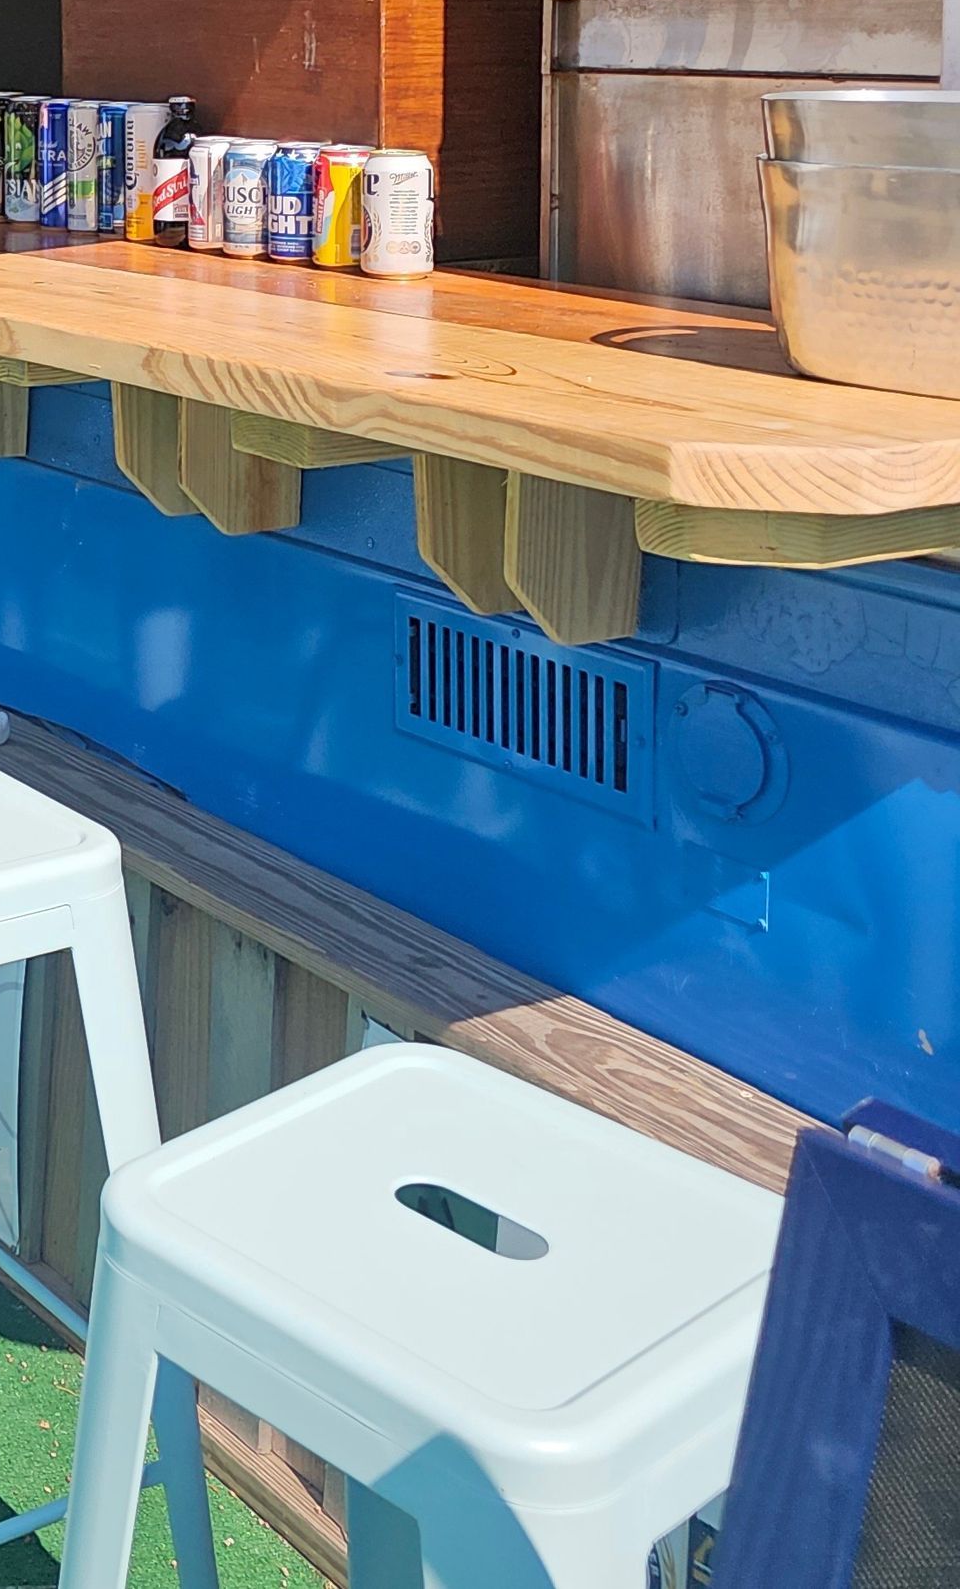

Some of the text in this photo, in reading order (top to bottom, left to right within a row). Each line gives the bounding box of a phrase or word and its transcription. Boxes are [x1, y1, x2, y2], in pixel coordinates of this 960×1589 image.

[38, 149, 67, 161] LTRA
[227, 205, 263, 215] LIGHT
[270, 195, 302, 215] UD
[269, 215, 313, 235] GHT
